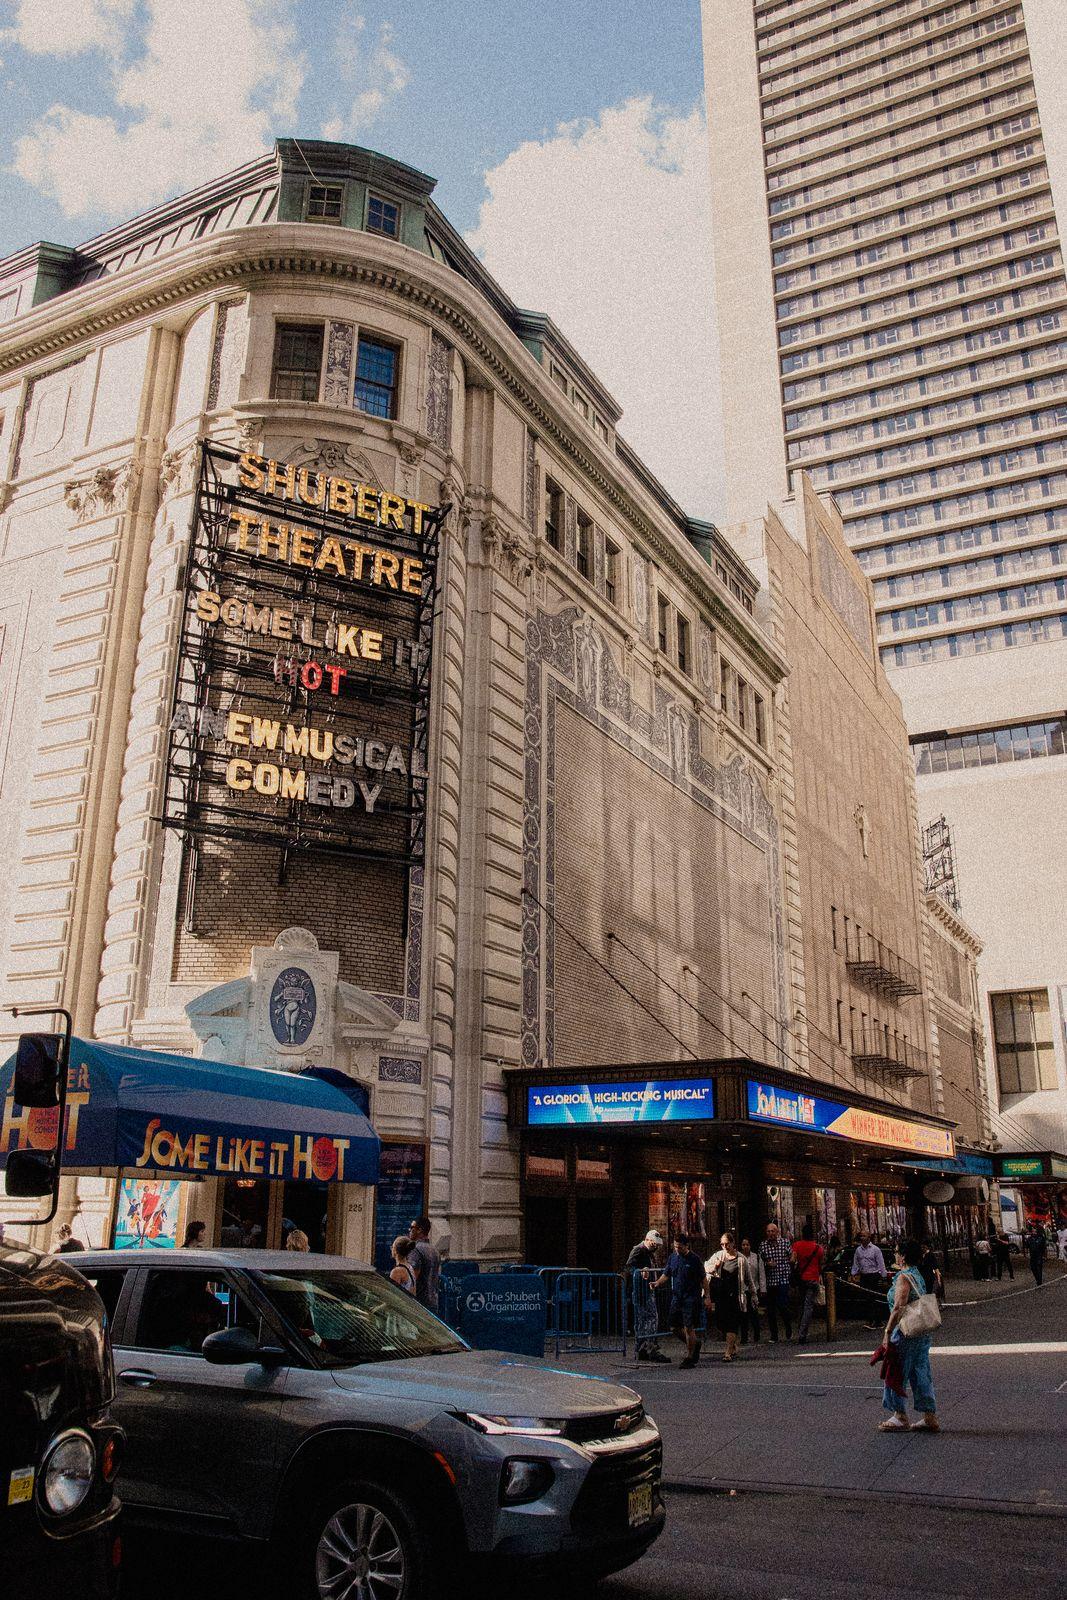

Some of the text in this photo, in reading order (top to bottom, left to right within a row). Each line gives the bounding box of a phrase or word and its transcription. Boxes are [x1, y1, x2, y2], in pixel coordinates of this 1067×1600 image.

[239, 452, 430, 535] SHUBERT
[229, 511, 424, 596] THEATRE
[196, 590, 426, 668] SOME LIKE IT
[274, 655, 348, 696] HOT
[168, 701, 429, 779] A NEW MUSICAL
[225, 758, 383, 813] COMEDY
[594, 1090, 661, 1103] HIGH-KICKING
[136, 1118, 211, 1169] SOME
[292, 1134, 350, 1182] HOT
[348, 1203, 363, 1213] 225
[485, 1291, 541, 1302] The Shubert
[485, 1302, 541, 1313] Organization
